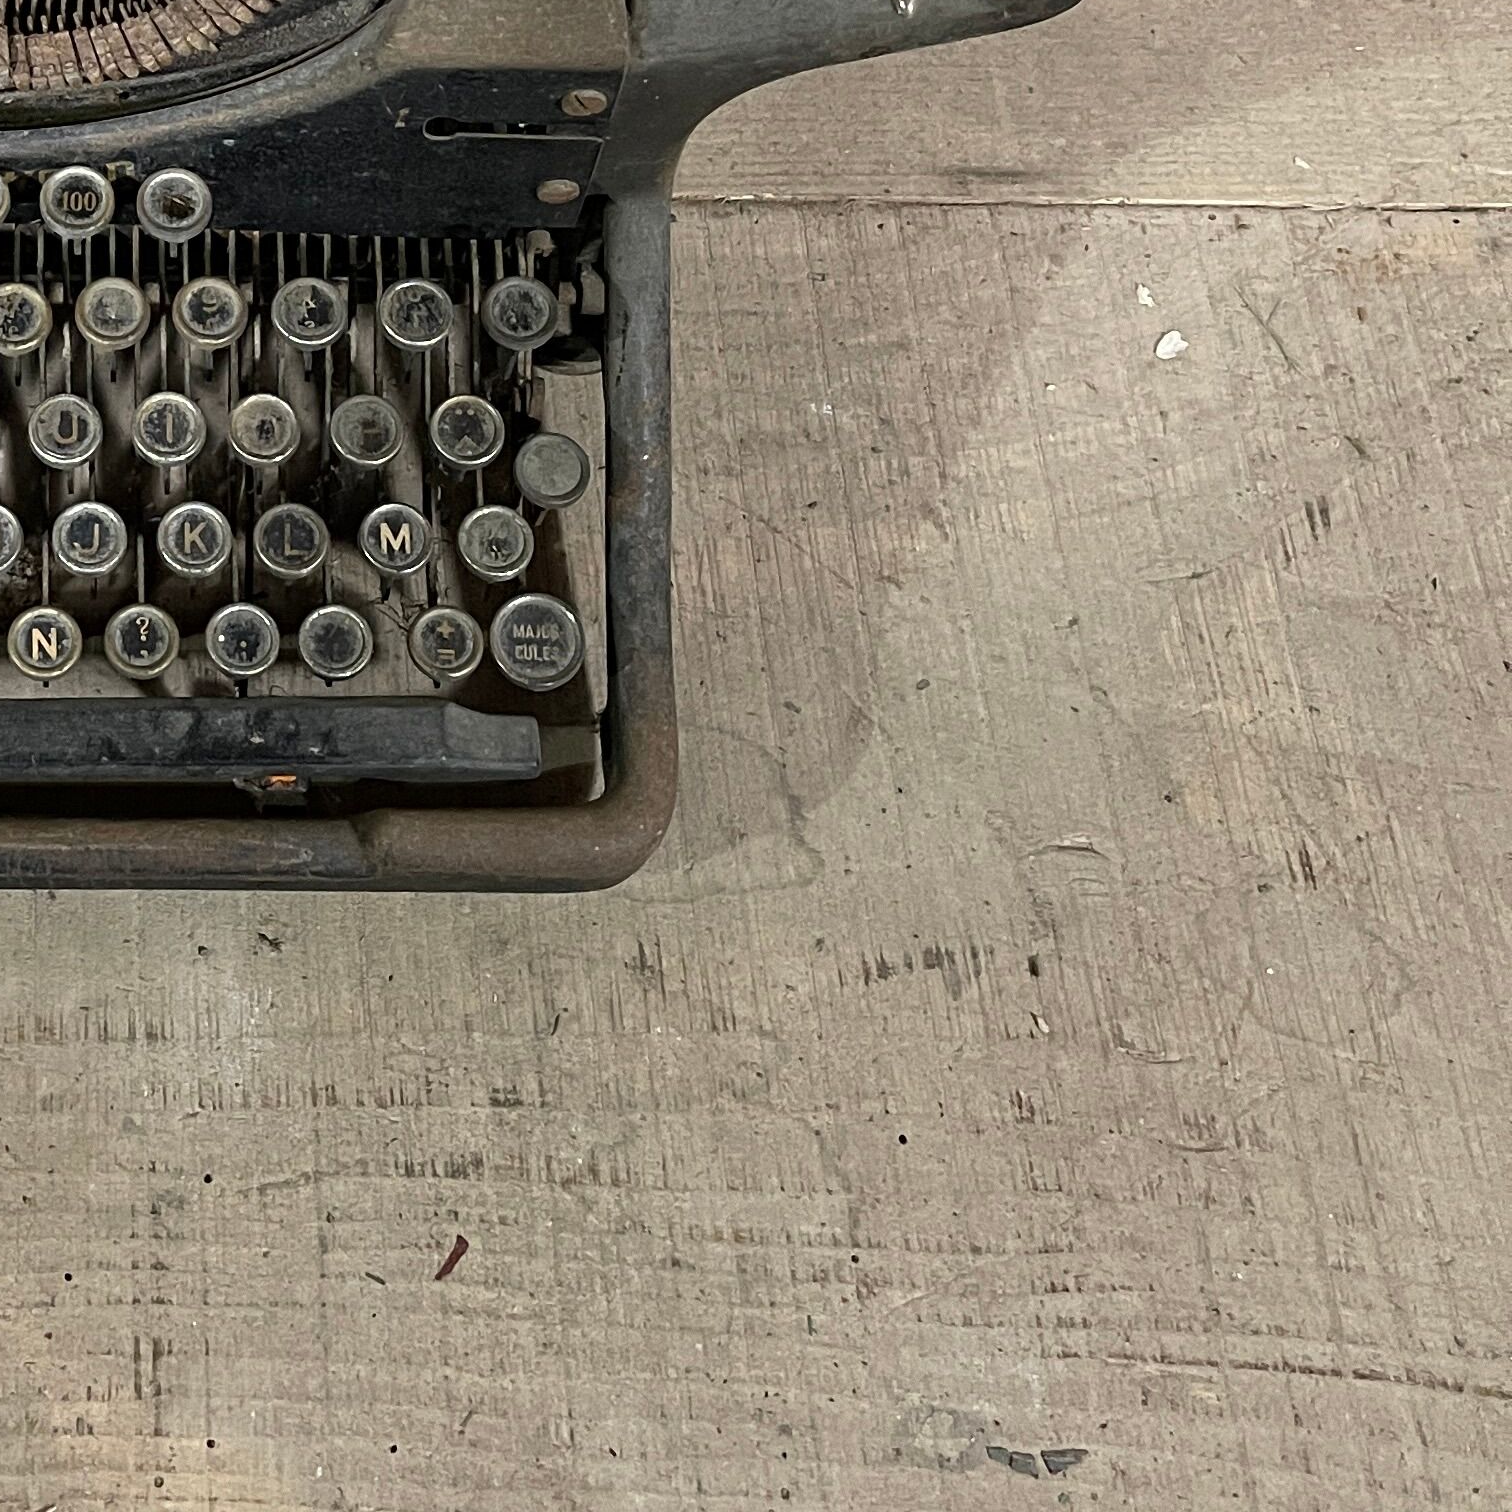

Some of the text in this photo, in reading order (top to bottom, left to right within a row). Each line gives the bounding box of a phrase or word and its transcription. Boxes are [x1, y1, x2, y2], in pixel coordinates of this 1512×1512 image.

[61, 190, 96, 212] 100
[72, 522, 100, 555] J
[183, 520, 209, 555] K
[283, 522, 305, 557] L
[379, 522, 412, 556] M
[31, 627, 58, 662] N
